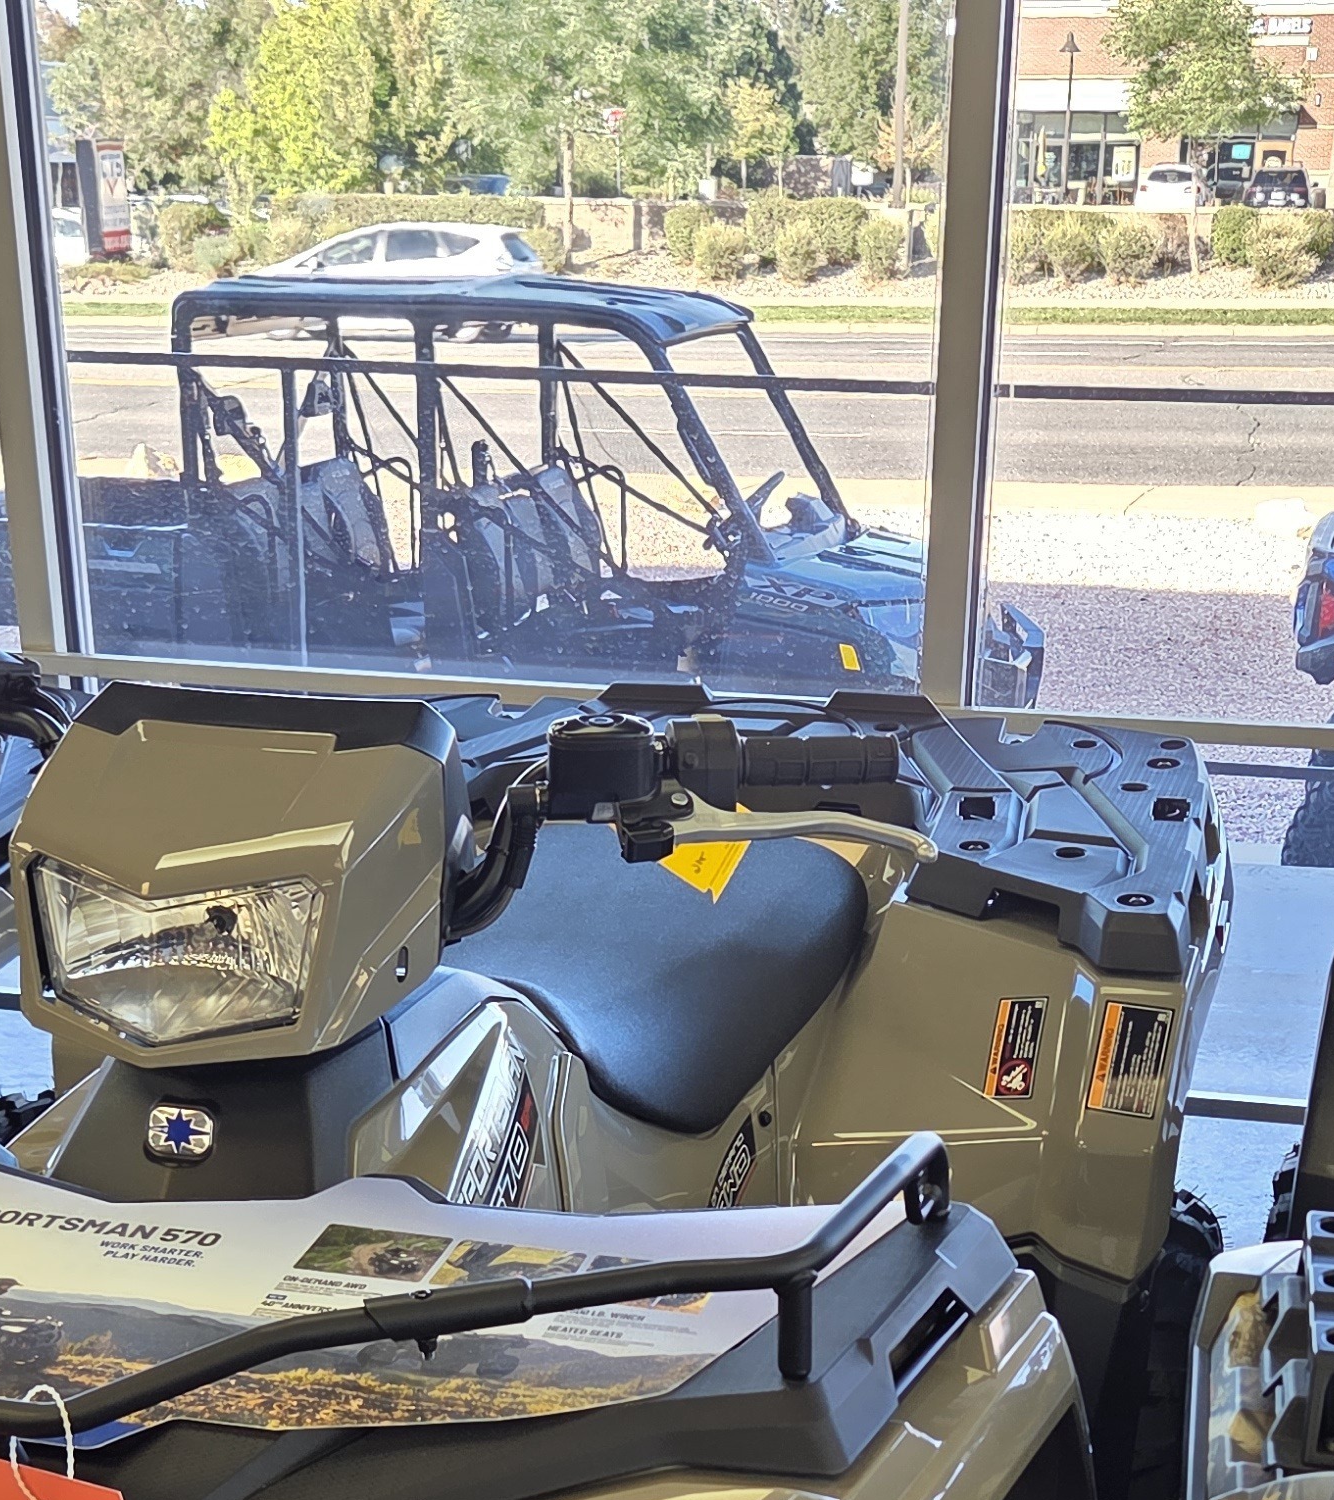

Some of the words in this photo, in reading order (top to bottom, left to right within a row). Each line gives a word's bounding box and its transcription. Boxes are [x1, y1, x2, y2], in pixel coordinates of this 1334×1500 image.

[749, 591, 809, 613] 1000
[159, 1226, 223, 1248] 570
[99, 1239, 139, 1251] WORK
[141, 1244, 205, 1260] SMARTER.
[103, 1250, 139, 1261] PLAY
[140, 1254, 197, 1268] HARDER.
[282, 1274, 343, 1288] ON-DEMAND
[343, 1281, 368, 1291] AWD
[610, 1311, 646, 1322] WINCH
[547, 1324, 588, 1336] HEATED
[589, 1328, 624, 1339] SEATS
